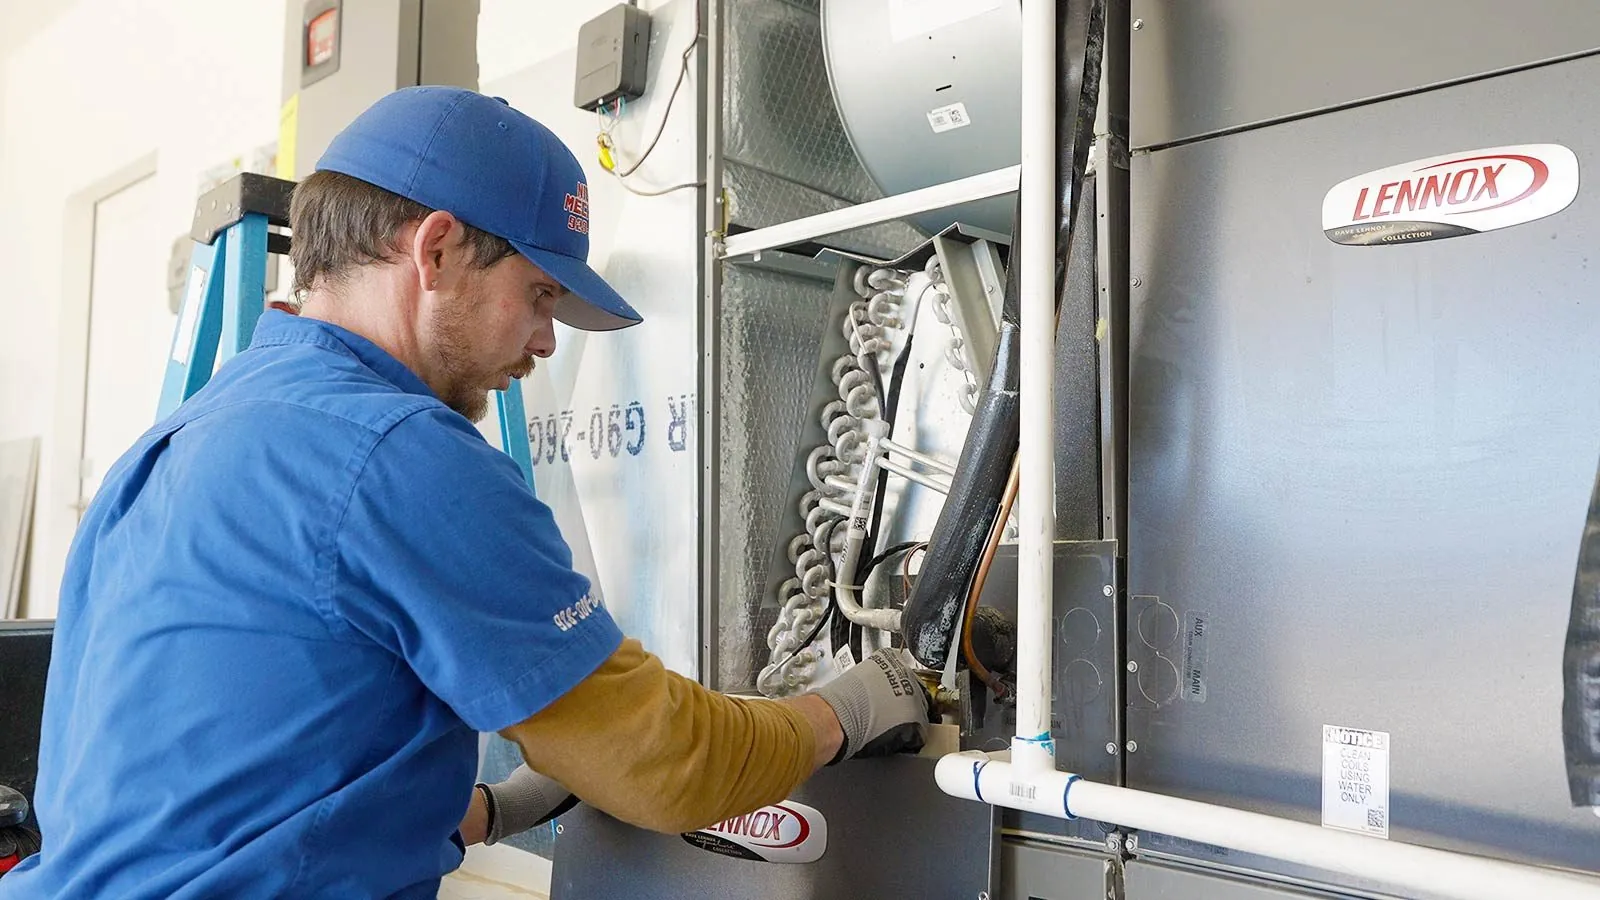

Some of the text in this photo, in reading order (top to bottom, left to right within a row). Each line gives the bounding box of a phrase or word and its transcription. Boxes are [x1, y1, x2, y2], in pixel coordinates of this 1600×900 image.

[1352, 163, 1506, 221] LENNOX
[1334, 225, 1387, 237] DAVE LENNOX
[1381, 231, 1433, 242] COLLECTION
[1194, 617, 1204, 637] AUX
[884, 669, 902, 697] FIRM
[1191, 669, 1201, 695] MAIN
[1340, 747, 1371, 761] CLEAN
[1341, 758, 1369, 773] COILS
[1340, 769, 1370, 784] USING
[1338, 780, 1372, 796] WATER
[706, 811, 786, 840] NNOX
